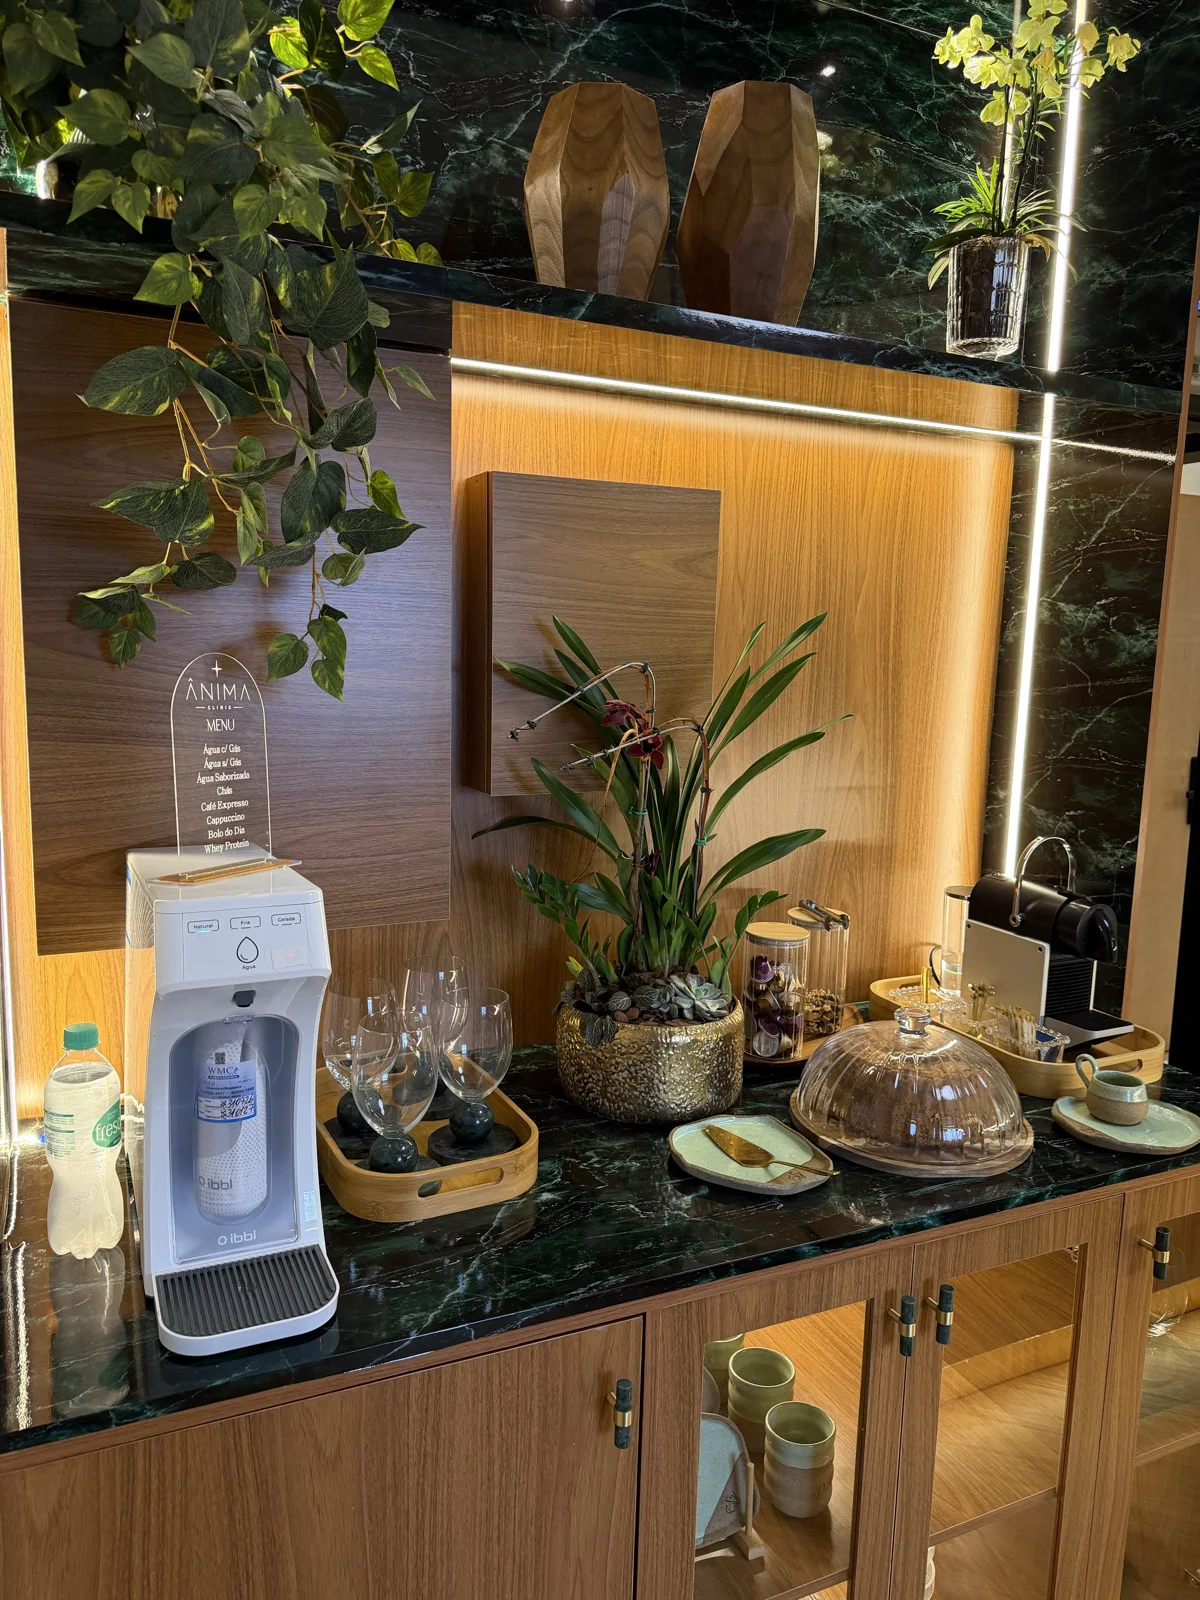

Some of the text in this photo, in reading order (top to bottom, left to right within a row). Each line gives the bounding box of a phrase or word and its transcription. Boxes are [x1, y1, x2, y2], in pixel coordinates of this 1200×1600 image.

[185, 677, 251, 701] ÂNIMA
[206, 718, 235, 732] MENU
[203, 743, 241, 755] Água c/ Gás
[203, 757, 242, 769] Água s/ Gás
[196, 770, 250, 784] Água Saborizada
[216, 786, 233, 795] Chás
[201, 800, 249, 811] Café Expresso
[206, 812, 245, 825] Cappuccino
[208, 826, 245, 839] Bolo do Dia
[204, 839, 250, 854] Whey Protein
[207, 1179, 233, 1190] ibbl
[230, 1229, 257, 1243] ibbl
